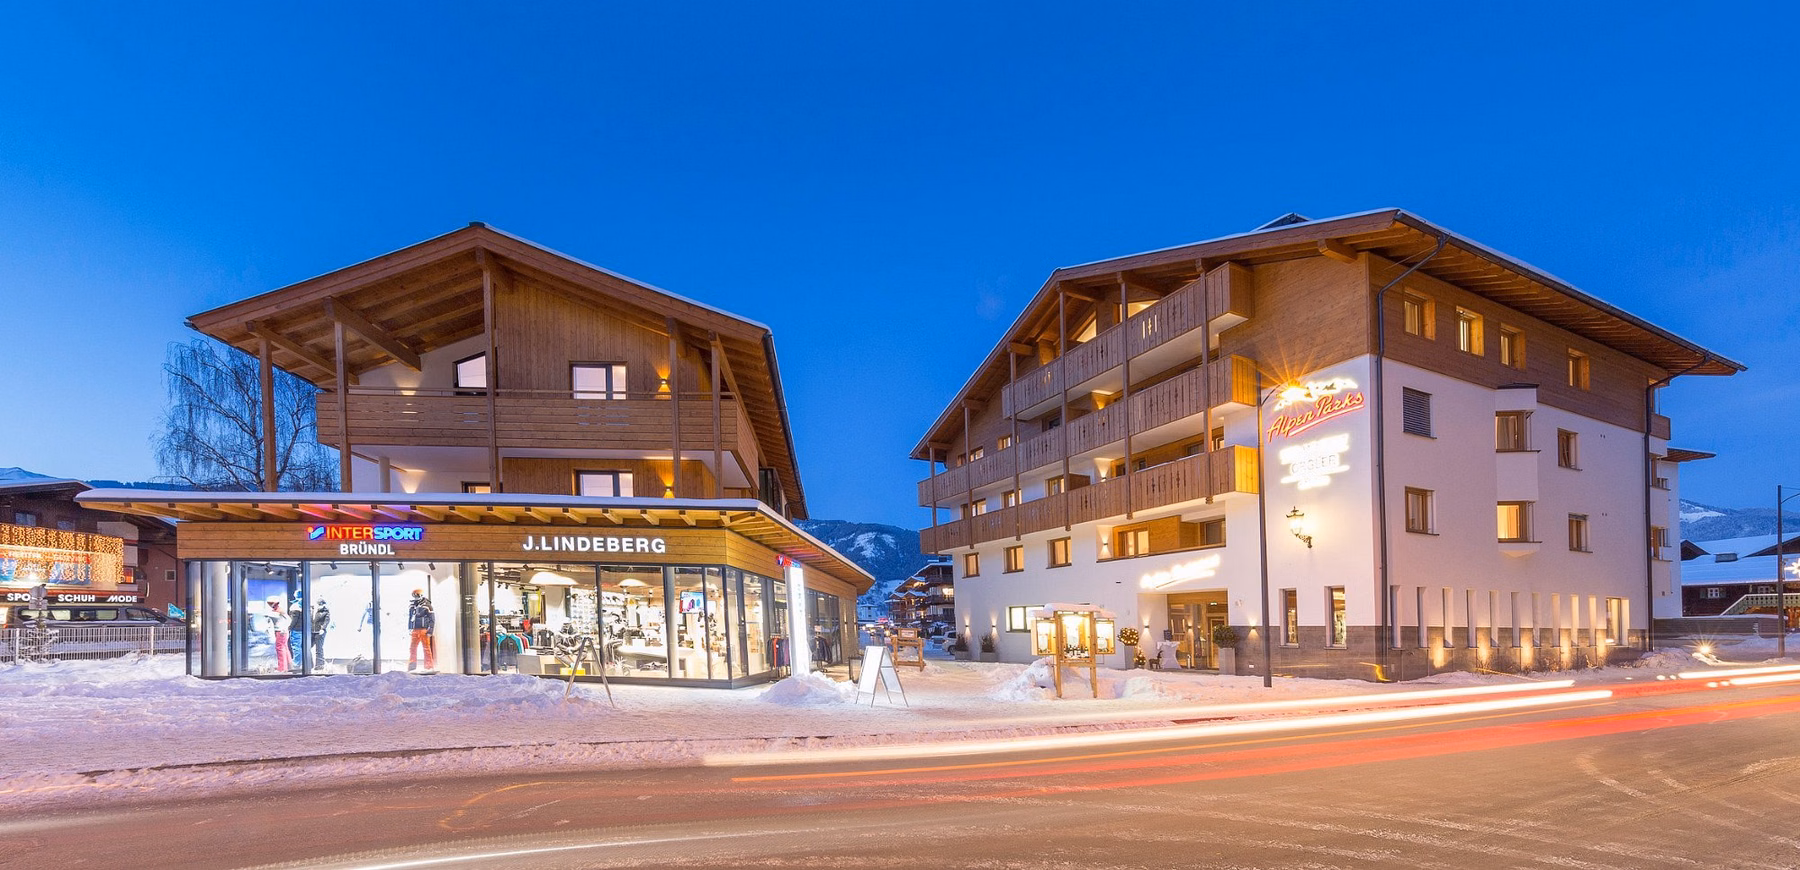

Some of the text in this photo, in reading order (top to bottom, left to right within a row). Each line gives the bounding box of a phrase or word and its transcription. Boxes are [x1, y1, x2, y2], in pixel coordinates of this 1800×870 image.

[1266, 391, 1364, 442] Alpen Parks
[326, 526, 423, 540] INTERSPORT
[340, 541, 395, 555] BRÜNDL
[522, 536, 666, 553] J.LINDEBERG
[7, 593, 138, 603] SPO SCHUH MODE
